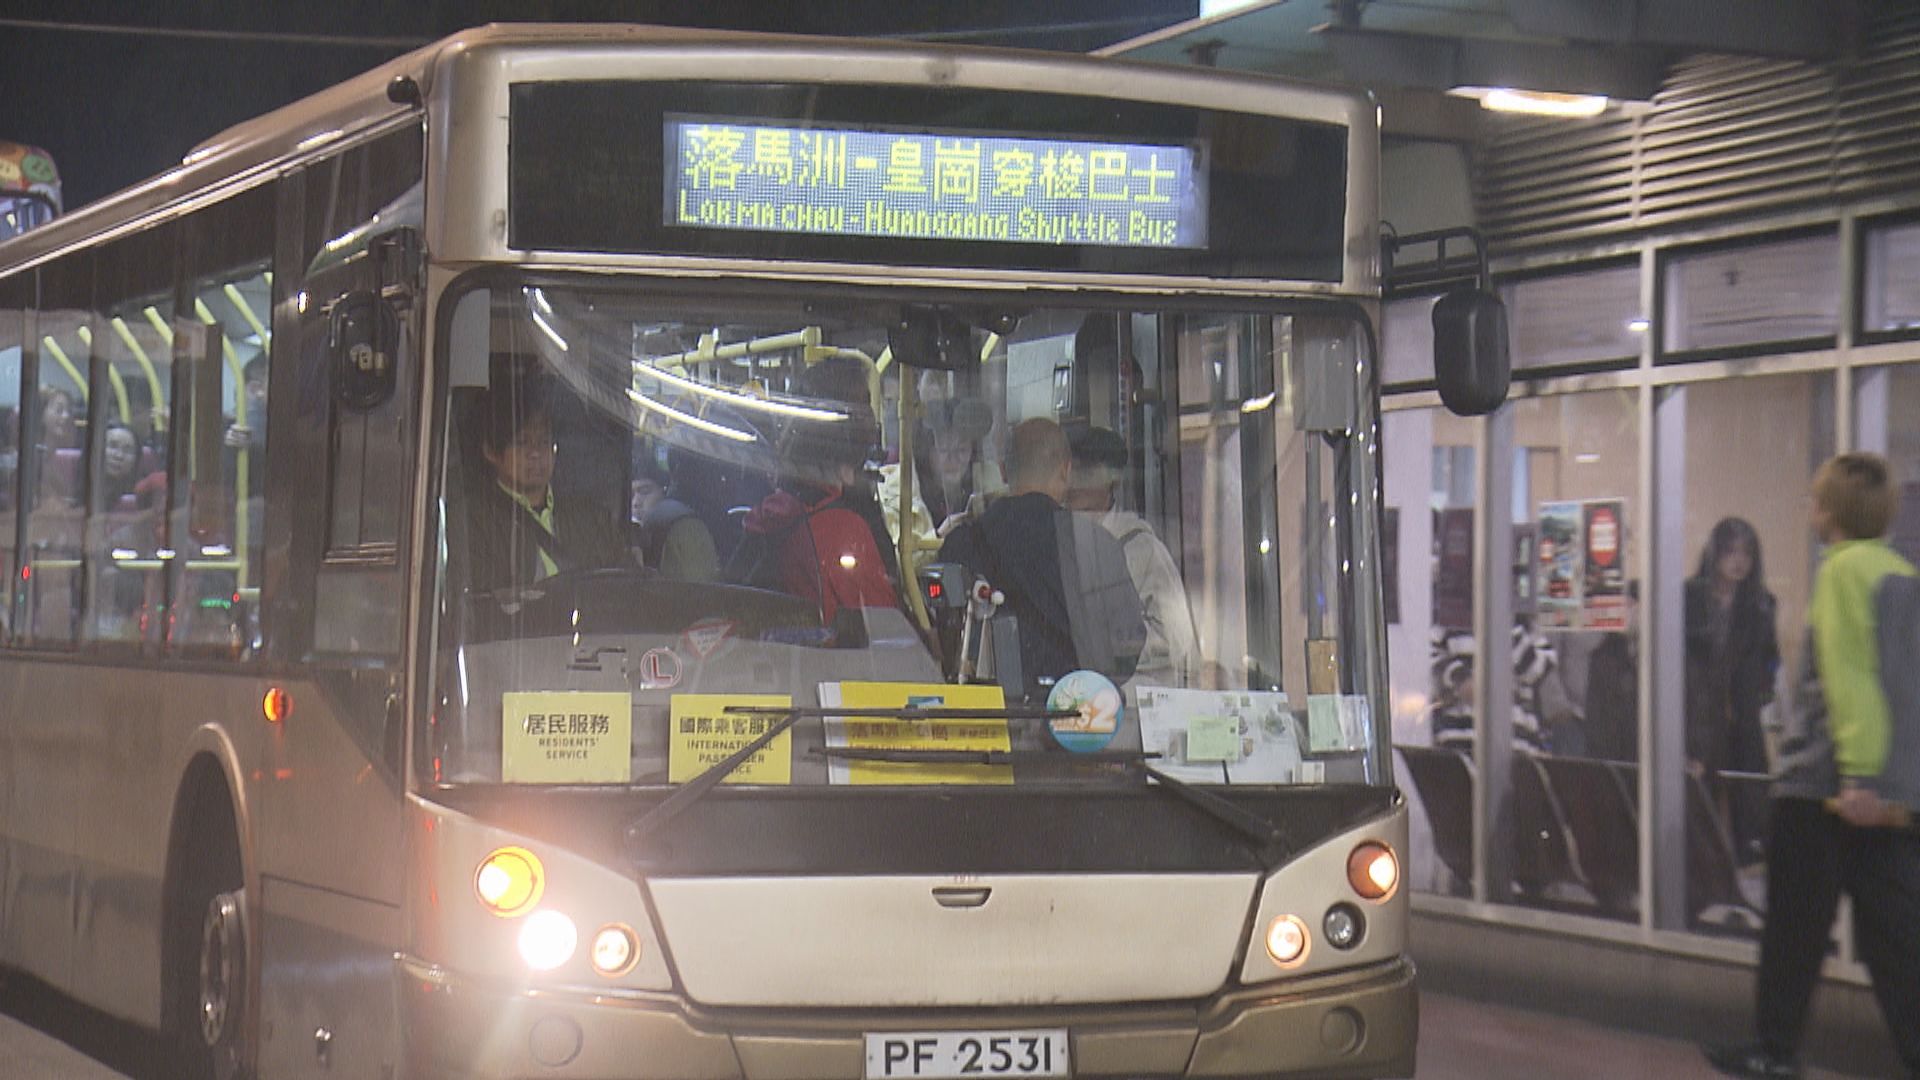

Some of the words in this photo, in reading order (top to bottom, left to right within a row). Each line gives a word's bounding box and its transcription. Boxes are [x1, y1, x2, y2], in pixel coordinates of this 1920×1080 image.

[1018, 206, 1119, 245] Shuttle
[1129, 210, 1177, 244] Bus
[527, 713, 610, 735] 居民服務
[545, 749, 589, 760] SERVICE
[686, 739, 774, 752] INTERNATIAL
[884, 1038, 938, 1076] PF
[958, 1036, 1051, 1074] 2531
